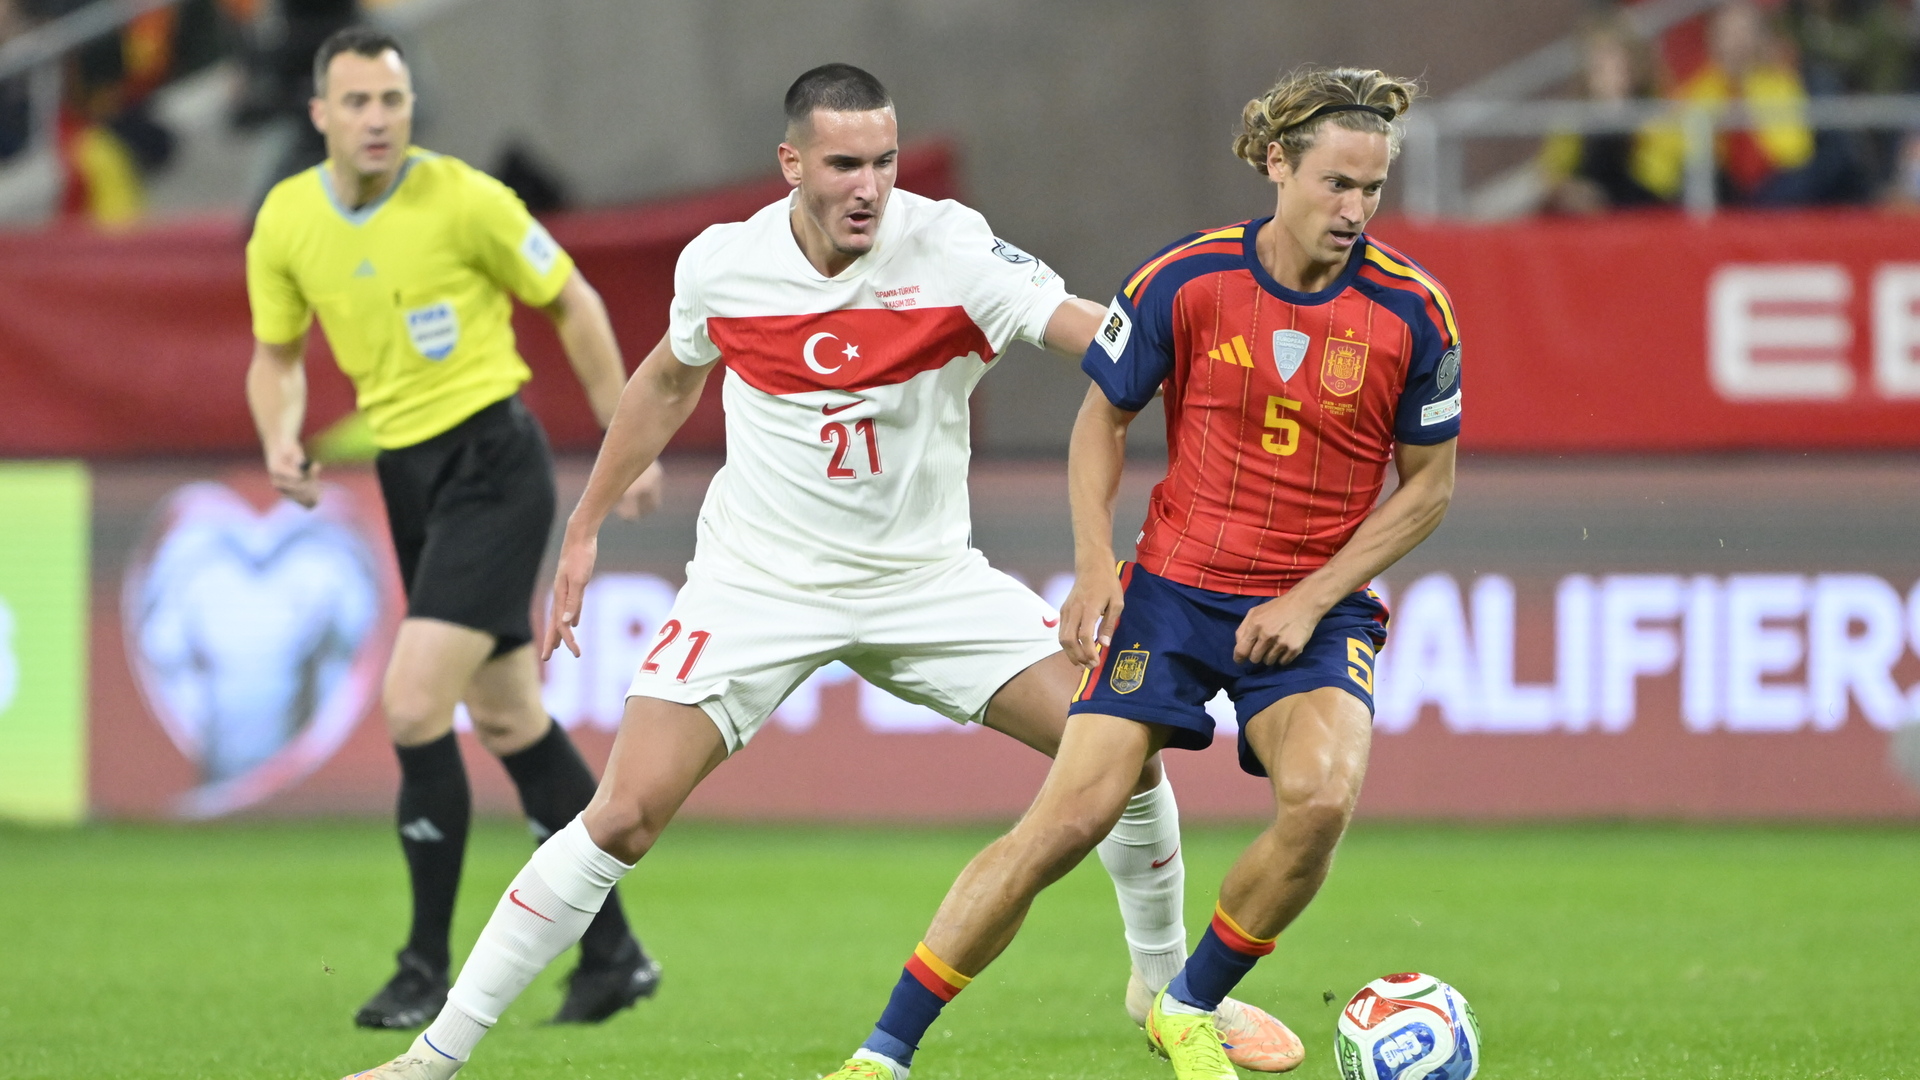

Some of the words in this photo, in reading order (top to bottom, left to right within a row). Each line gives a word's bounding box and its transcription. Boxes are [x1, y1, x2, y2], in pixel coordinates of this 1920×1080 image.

[1276, 335, 1306, 345] EUROPEAN
[820, 417, 883, 480] 21
[1261, 394, 1302, 456] 5
[640, 618, 712, 684] 21
[1204, 572, 1920, 733] ALIFIER
[1346, 637, 1374, 695] 5
